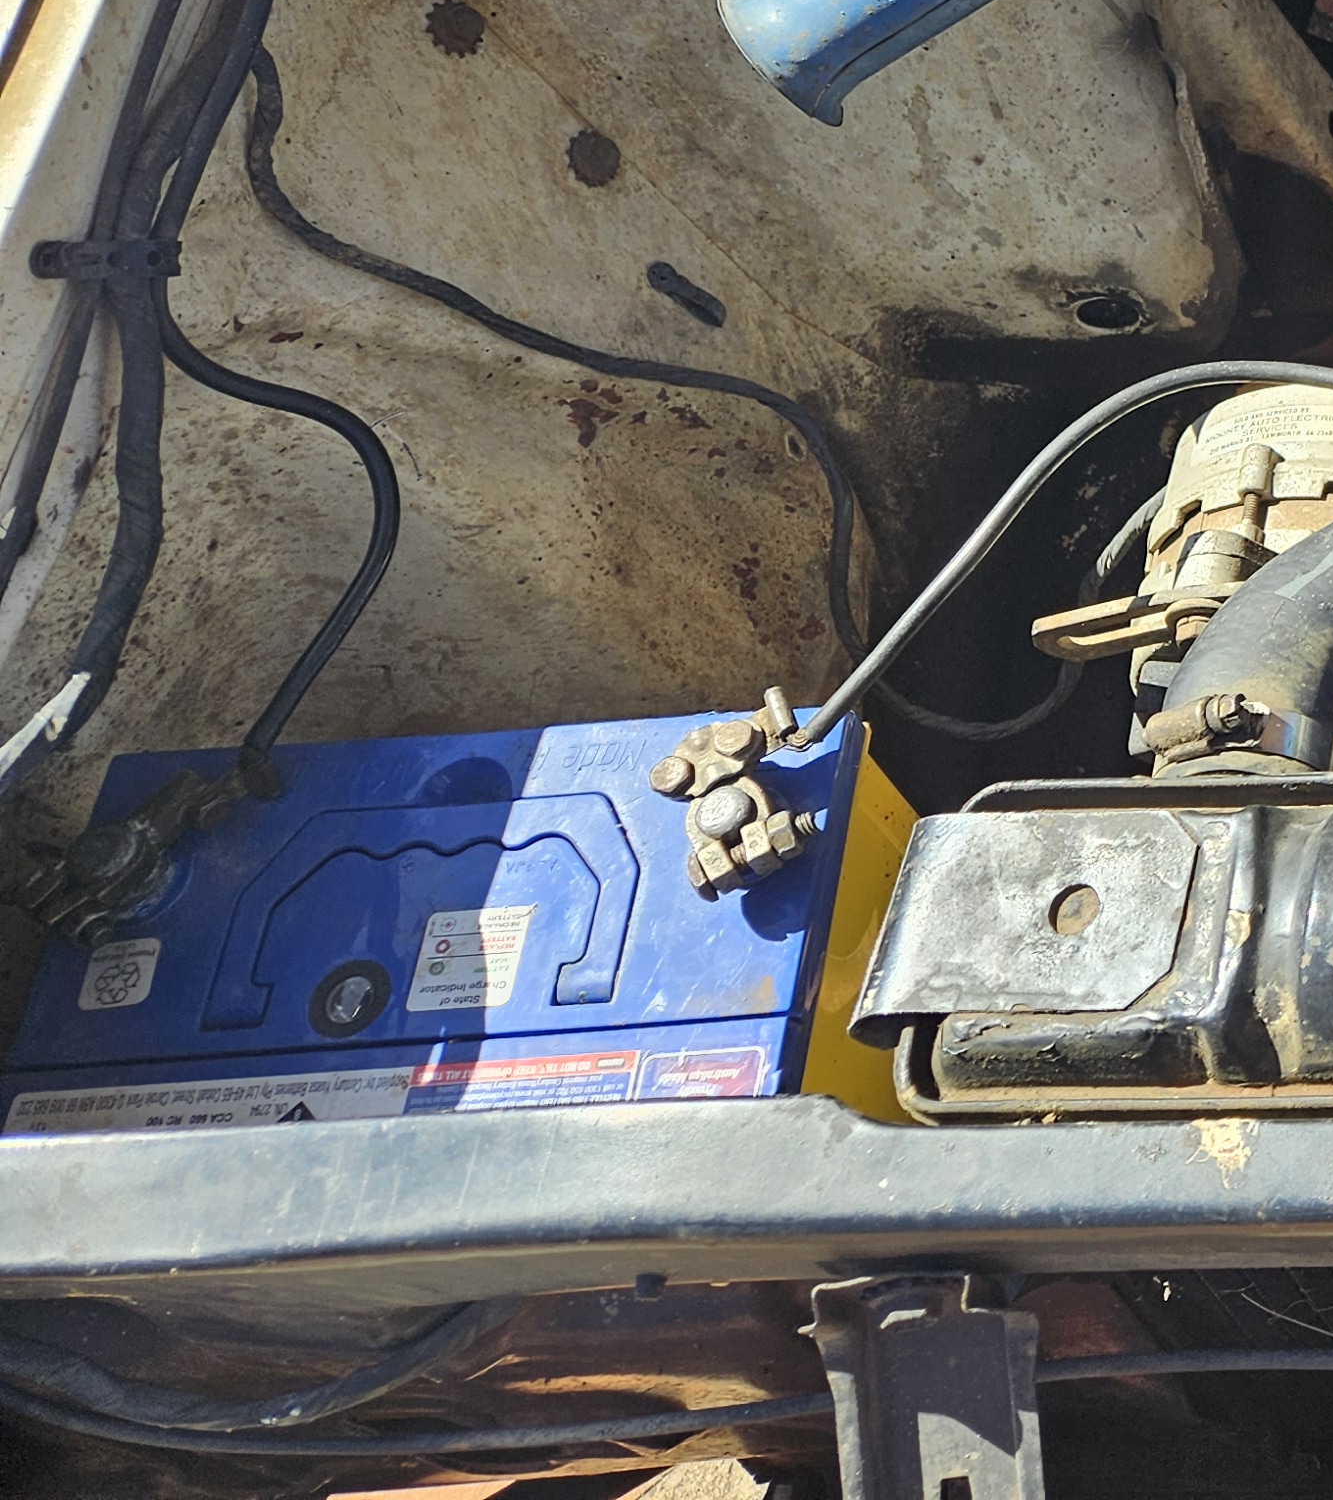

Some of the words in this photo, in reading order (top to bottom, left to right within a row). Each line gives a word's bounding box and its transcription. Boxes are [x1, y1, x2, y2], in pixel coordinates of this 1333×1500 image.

[1249, 415, 1280, 429] AUTO
[562, 740, 648, 777] Made
[478, 942, 517, 952] REPLACE
[419, 982, 467, 995] Indicator
[439, 996, 452, 1007] of
[453, 994, 481, 1007] State
[378, 1073, 410, 1092] Supplied
[445, 1071, 462, 1082] ALL
[658, 1071, 689, 1086] Made
[686, 1069, 741, 1083] Australian
[261, 1082, 274, 1101] Pty
[274, 1082, 309, 1098] Batteries
[336, 1074, 361, 1095] Century
[248, 1102, 272, 1119] 2794
[146, 1116, 164, 1128] 100
[166, 1115, 183, 1127] RC
[210, 1112, 234, 1124] CCA
